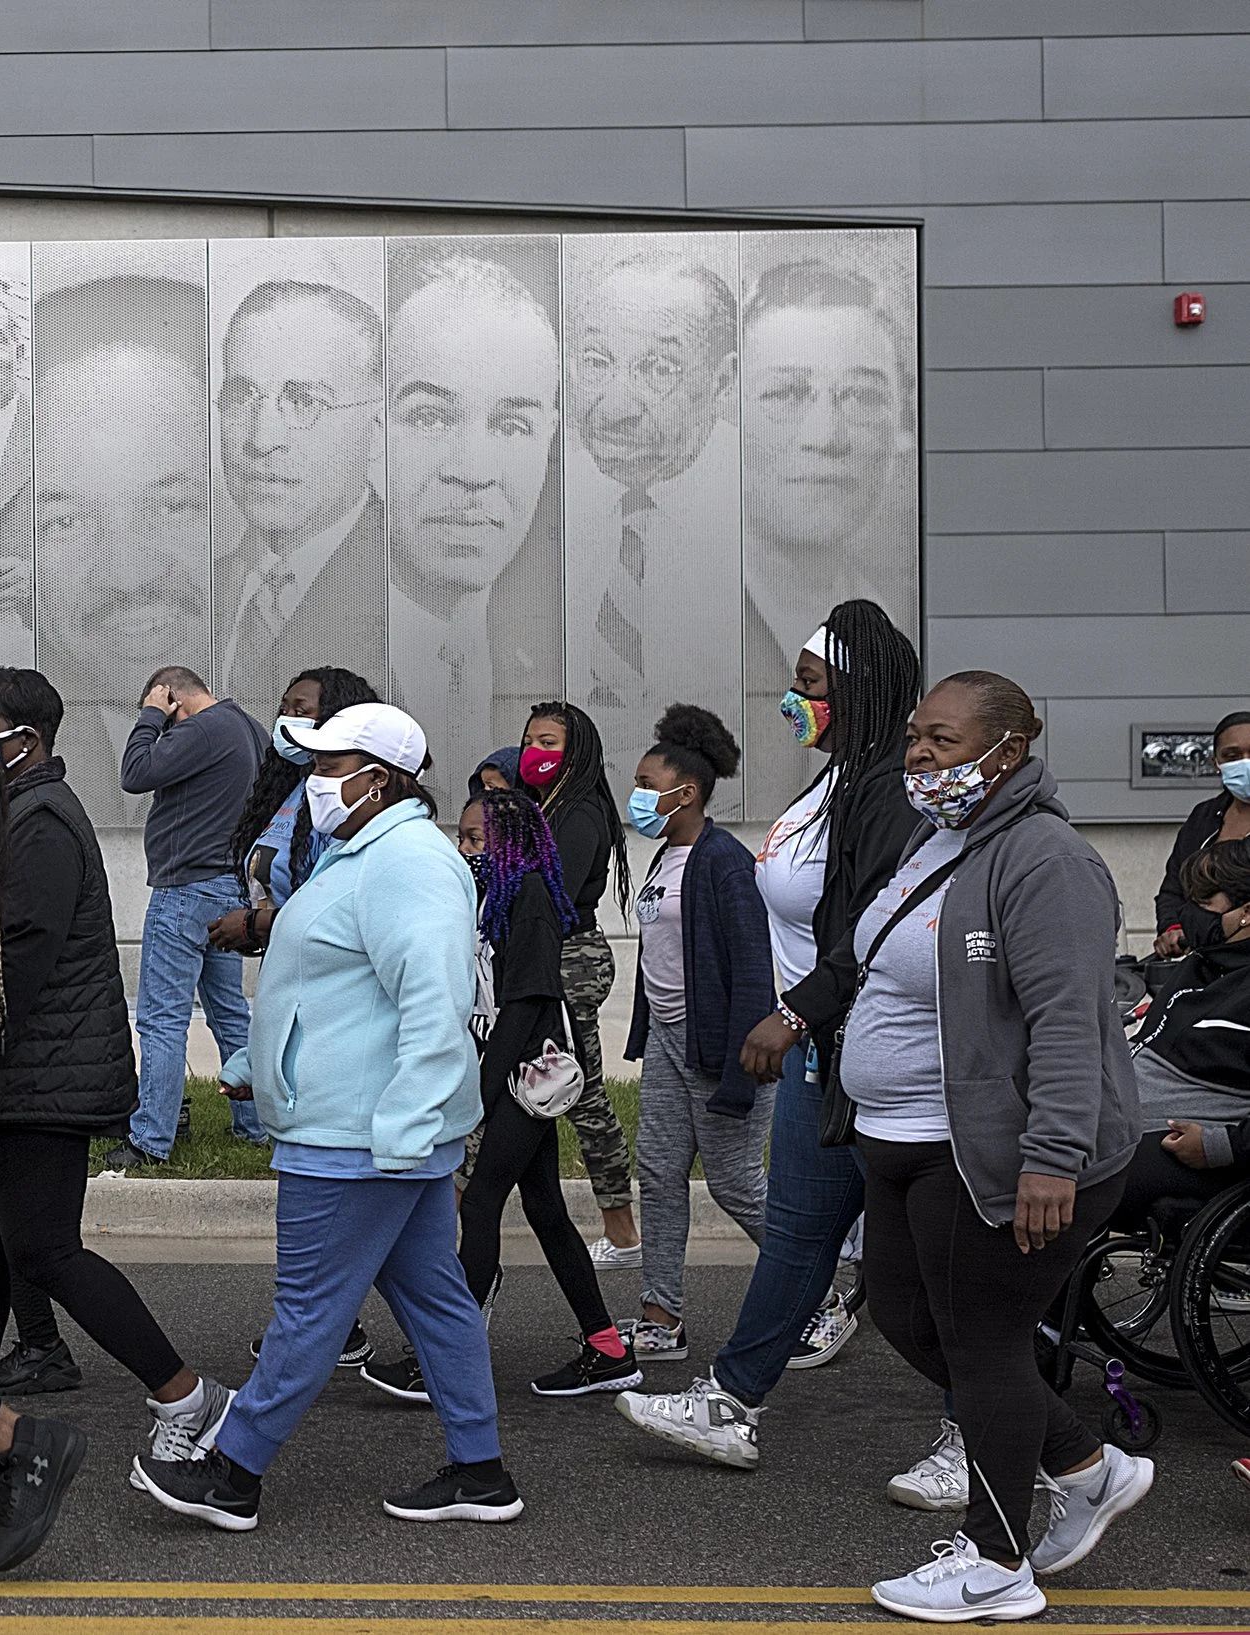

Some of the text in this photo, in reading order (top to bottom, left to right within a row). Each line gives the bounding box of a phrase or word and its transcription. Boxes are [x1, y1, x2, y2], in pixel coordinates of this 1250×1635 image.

[966, 939, 996, 949] DEMD
[967, 947, 991, 957] ACT
[1143, 1014, 1167, 1044] NIKE
